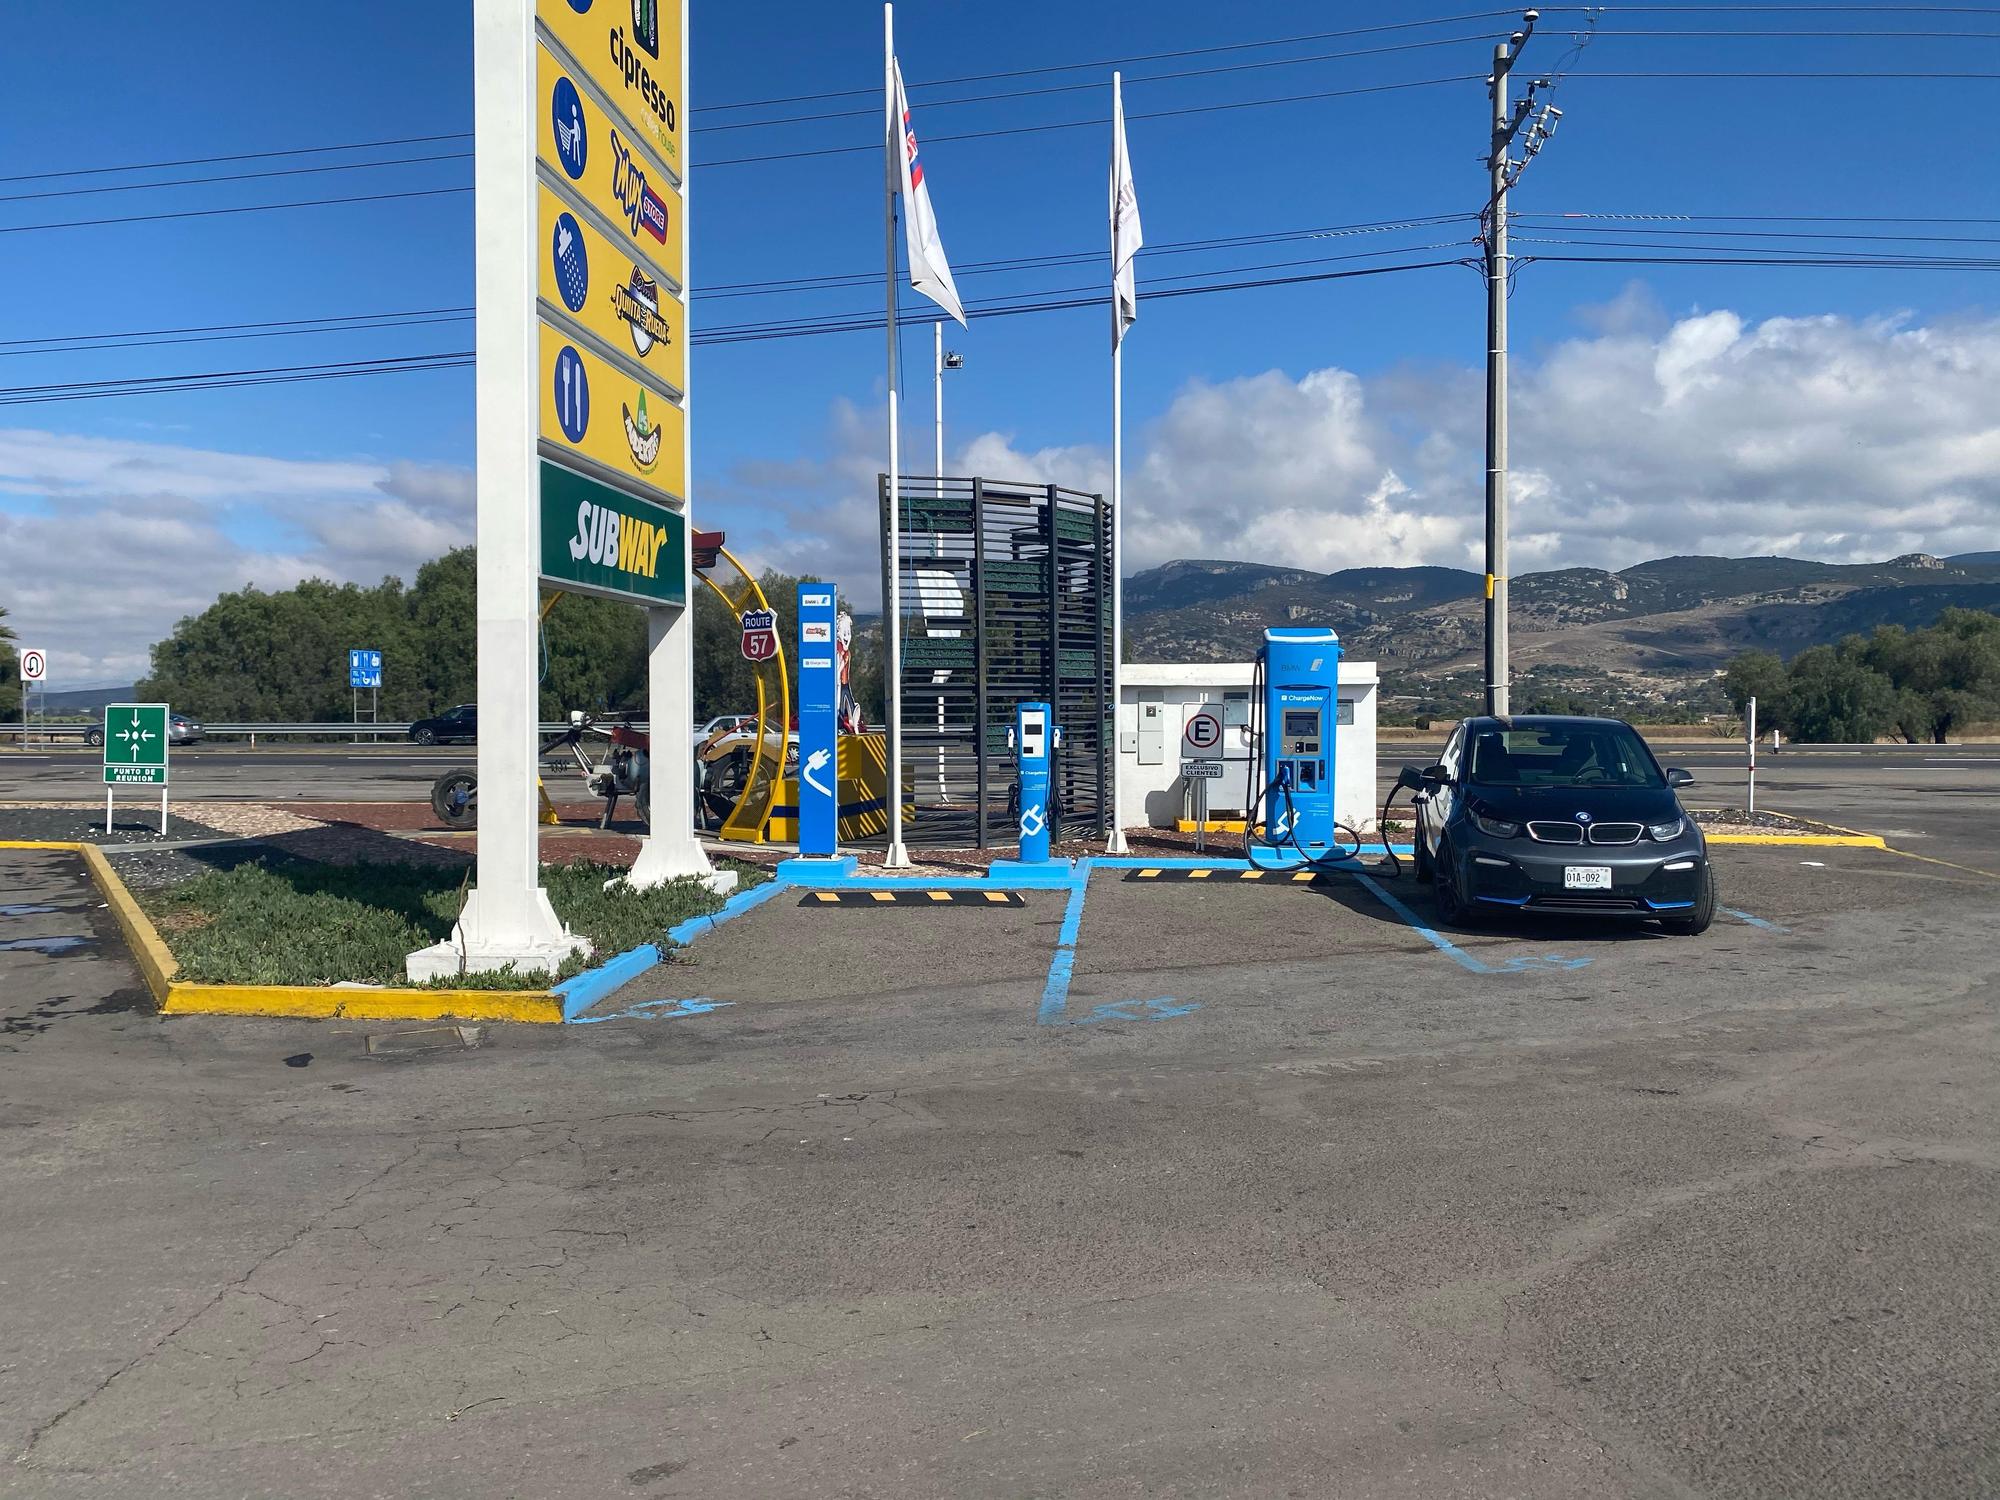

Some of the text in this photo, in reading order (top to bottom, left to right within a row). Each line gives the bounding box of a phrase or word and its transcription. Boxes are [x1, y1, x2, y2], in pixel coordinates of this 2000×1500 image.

[609, 25, 675, 133] cipresso
[643, 196, 665, 231] STORE
[615, 285, 641, 323] QUINTA
[568, 500, 668, 579] SUBWAY
[745, 616, 771, 628] ROUTE
[750, 634, 768, 655] 57
[1288, 694, 1323, 702] ChargeNow
[1194, 720, 1211, 741] E
[113, 767, 156, 776] PUNTO DE
[115, 774, 154, 782] REUNION
